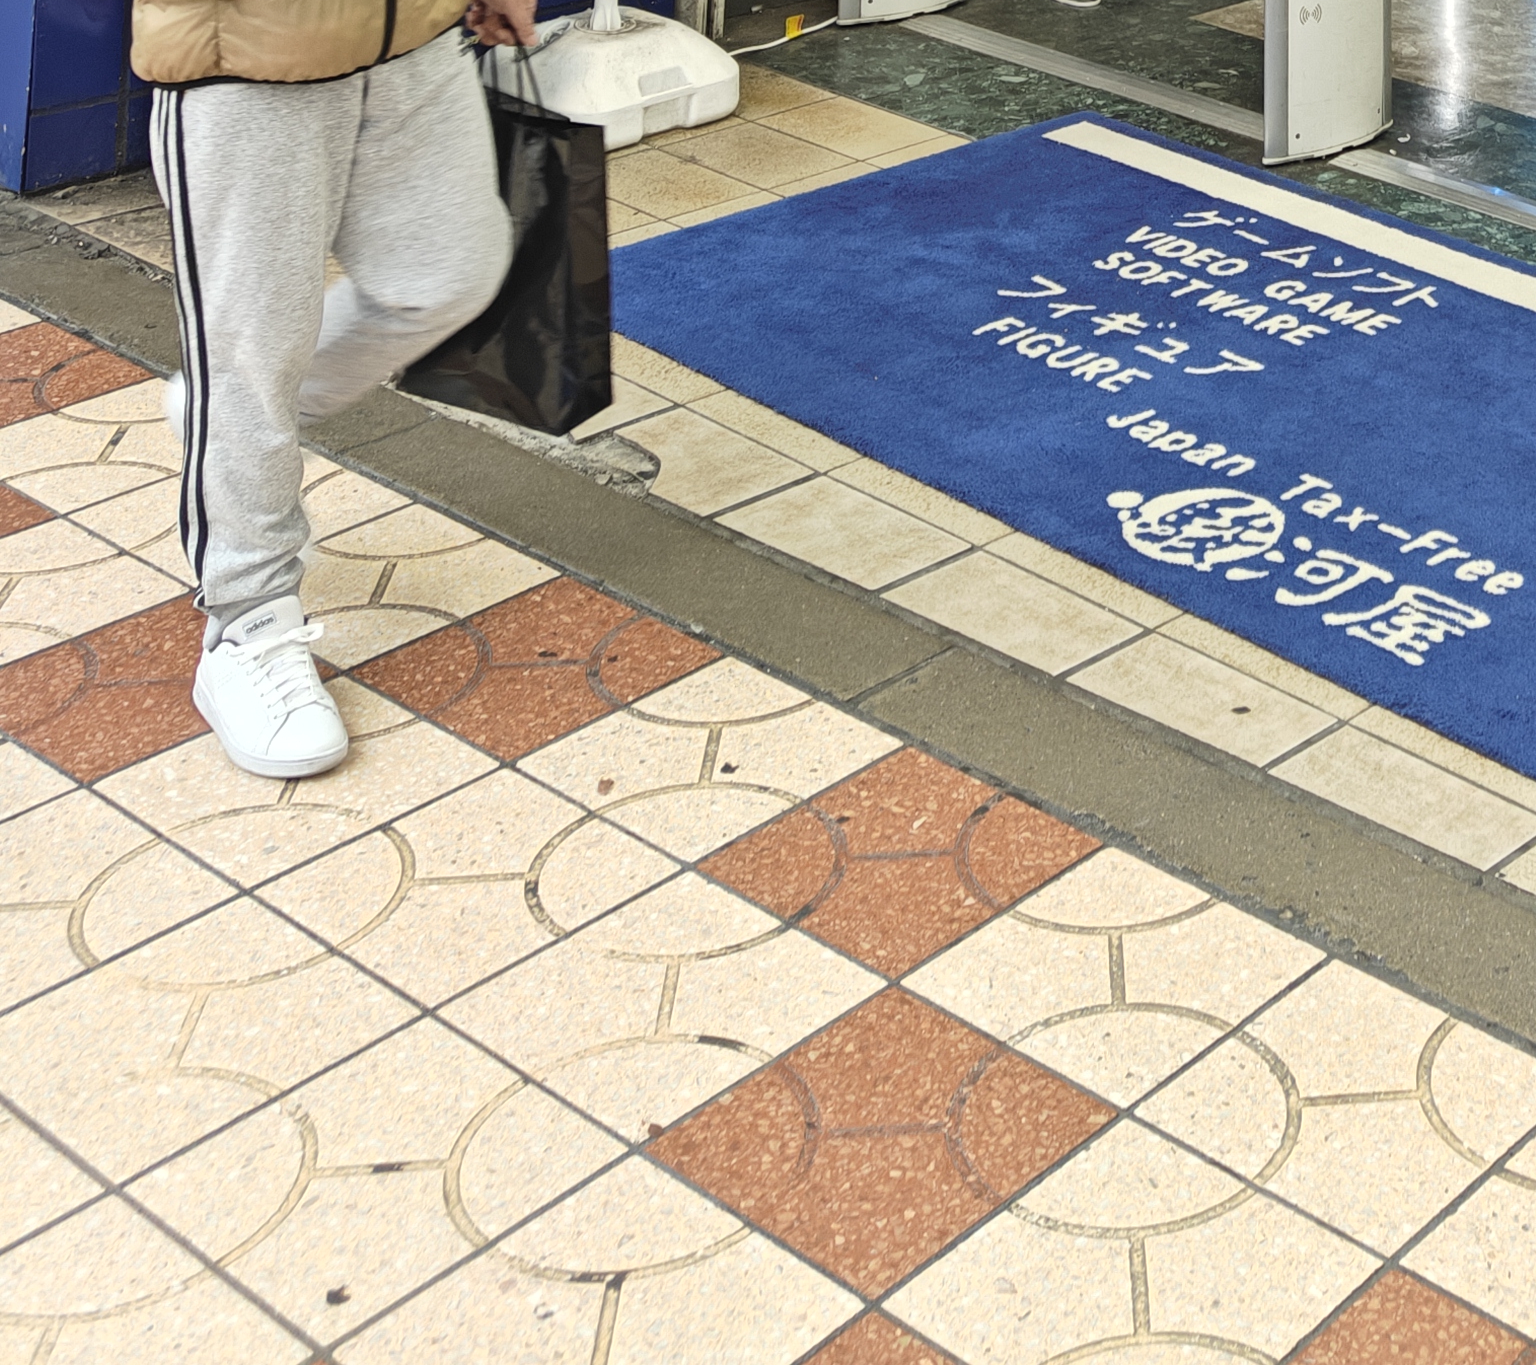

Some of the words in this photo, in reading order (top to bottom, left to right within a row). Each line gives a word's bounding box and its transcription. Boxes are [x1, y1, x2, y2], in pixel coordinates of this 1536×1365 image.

[1092, 251, 1332, 349] SOFTWARE
[1124, 226, 1250, 278] VIDEO
[1262, 277, 1403, 337] GAME
[1173, 209, 1440, 309] ゲームソフト
[972, 317, 1154, 395] FIGURE
[997, 275, 1265, 377] フィギュア
[1105, 407, 1257, 478] Japan
[1280, 472, 1526, 596] Tax-free
